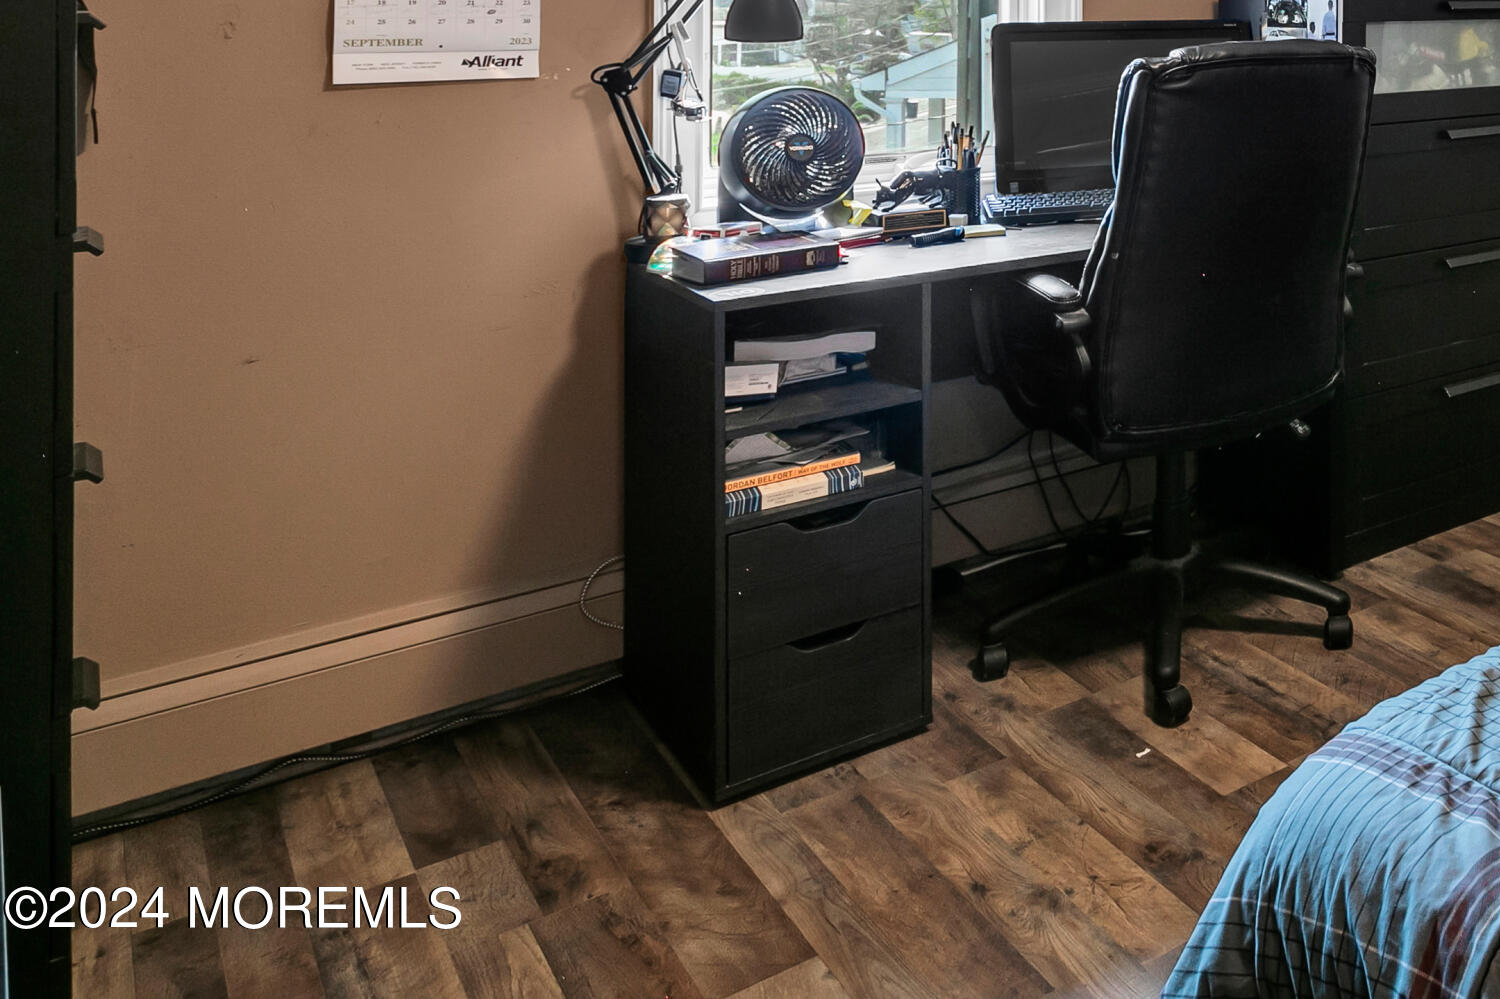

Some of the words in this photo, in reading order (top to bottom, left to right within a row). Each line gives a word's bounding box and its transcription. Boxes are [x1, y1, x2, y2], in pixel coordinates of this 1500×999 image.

[343, 38, 424, 48] SEPTEMBER
[509, 36, 533, 46] 2023
[470, 55, 524, 67] Alliant
[757, 470, 793, 485] BELFORT
